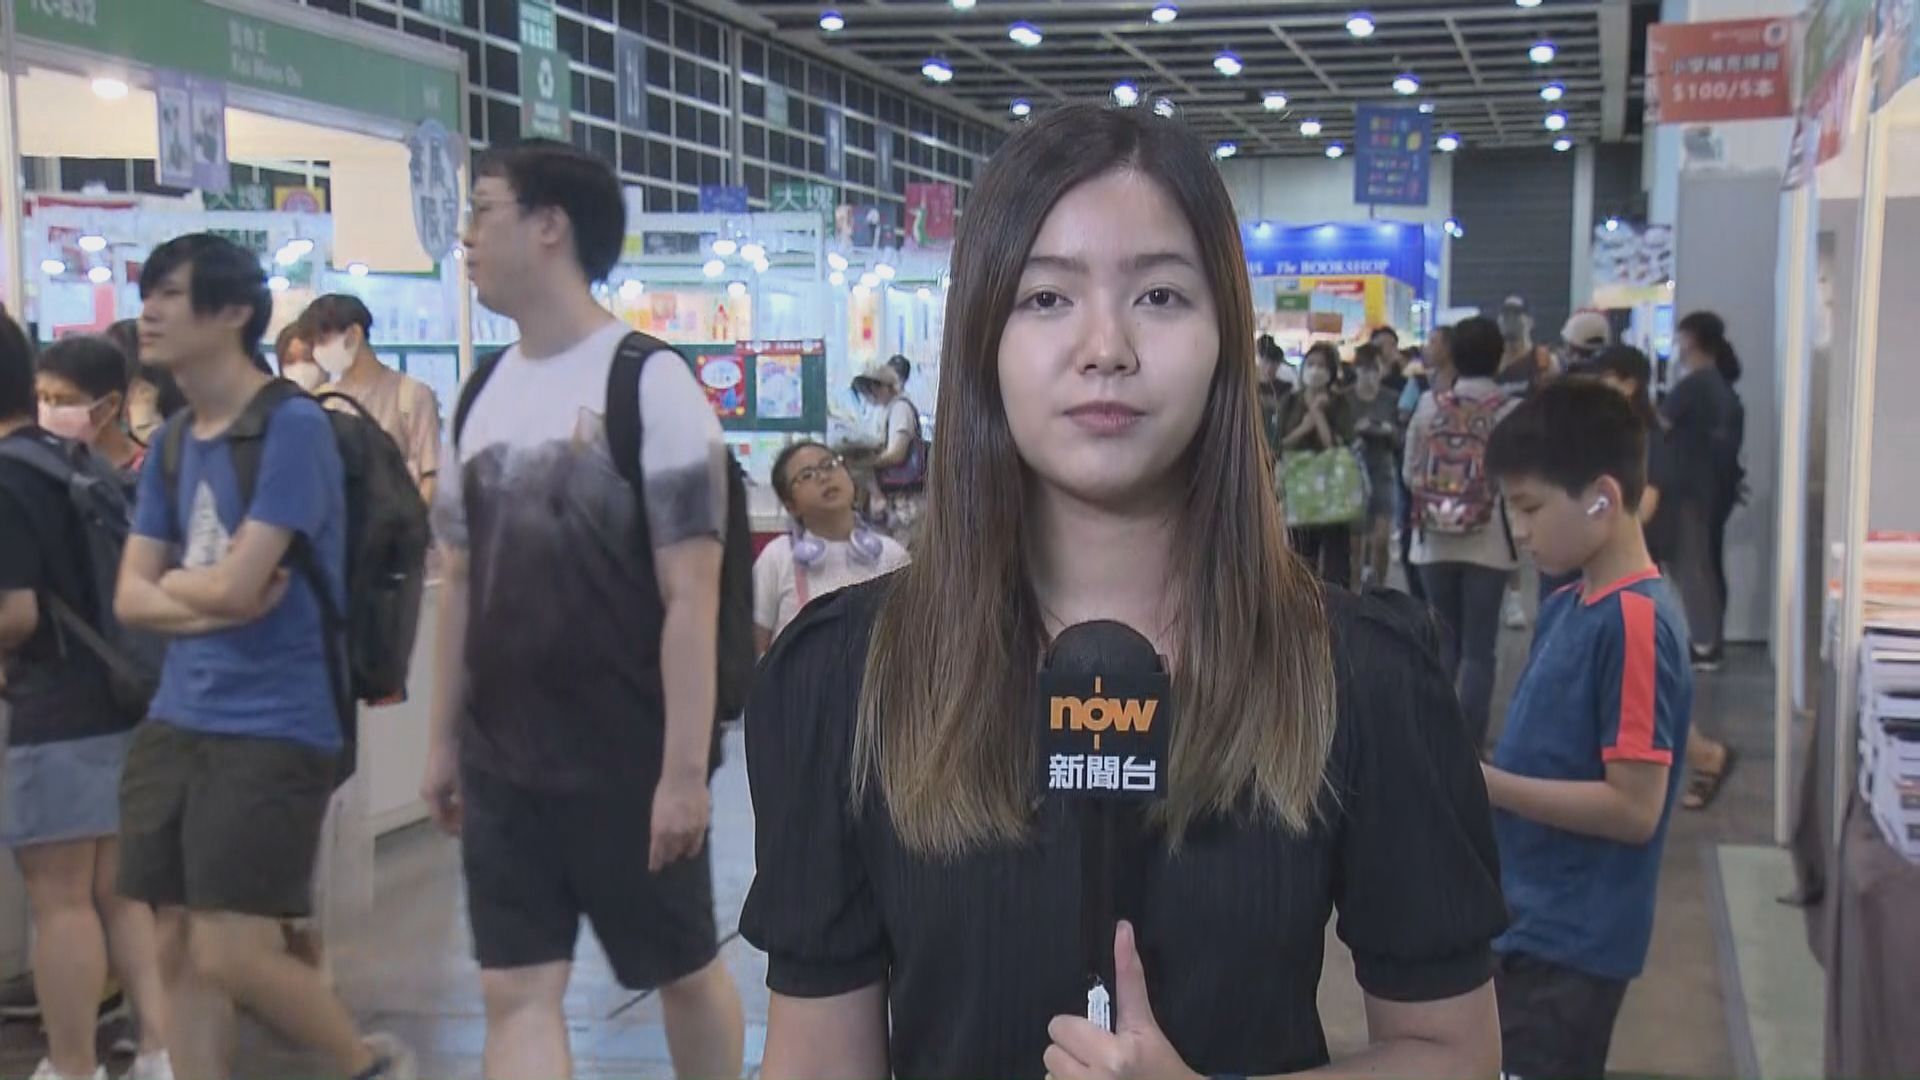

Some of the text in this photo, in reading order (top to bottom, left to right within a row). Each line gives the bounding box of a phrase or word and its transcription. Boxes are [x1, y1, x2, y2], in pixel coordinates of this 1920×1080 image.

[1301, 259, 1389, 275] BOOKSHOP
[1050, 696, 1159, 732] now
[1048, 753, 1156, 791] 新聞台
